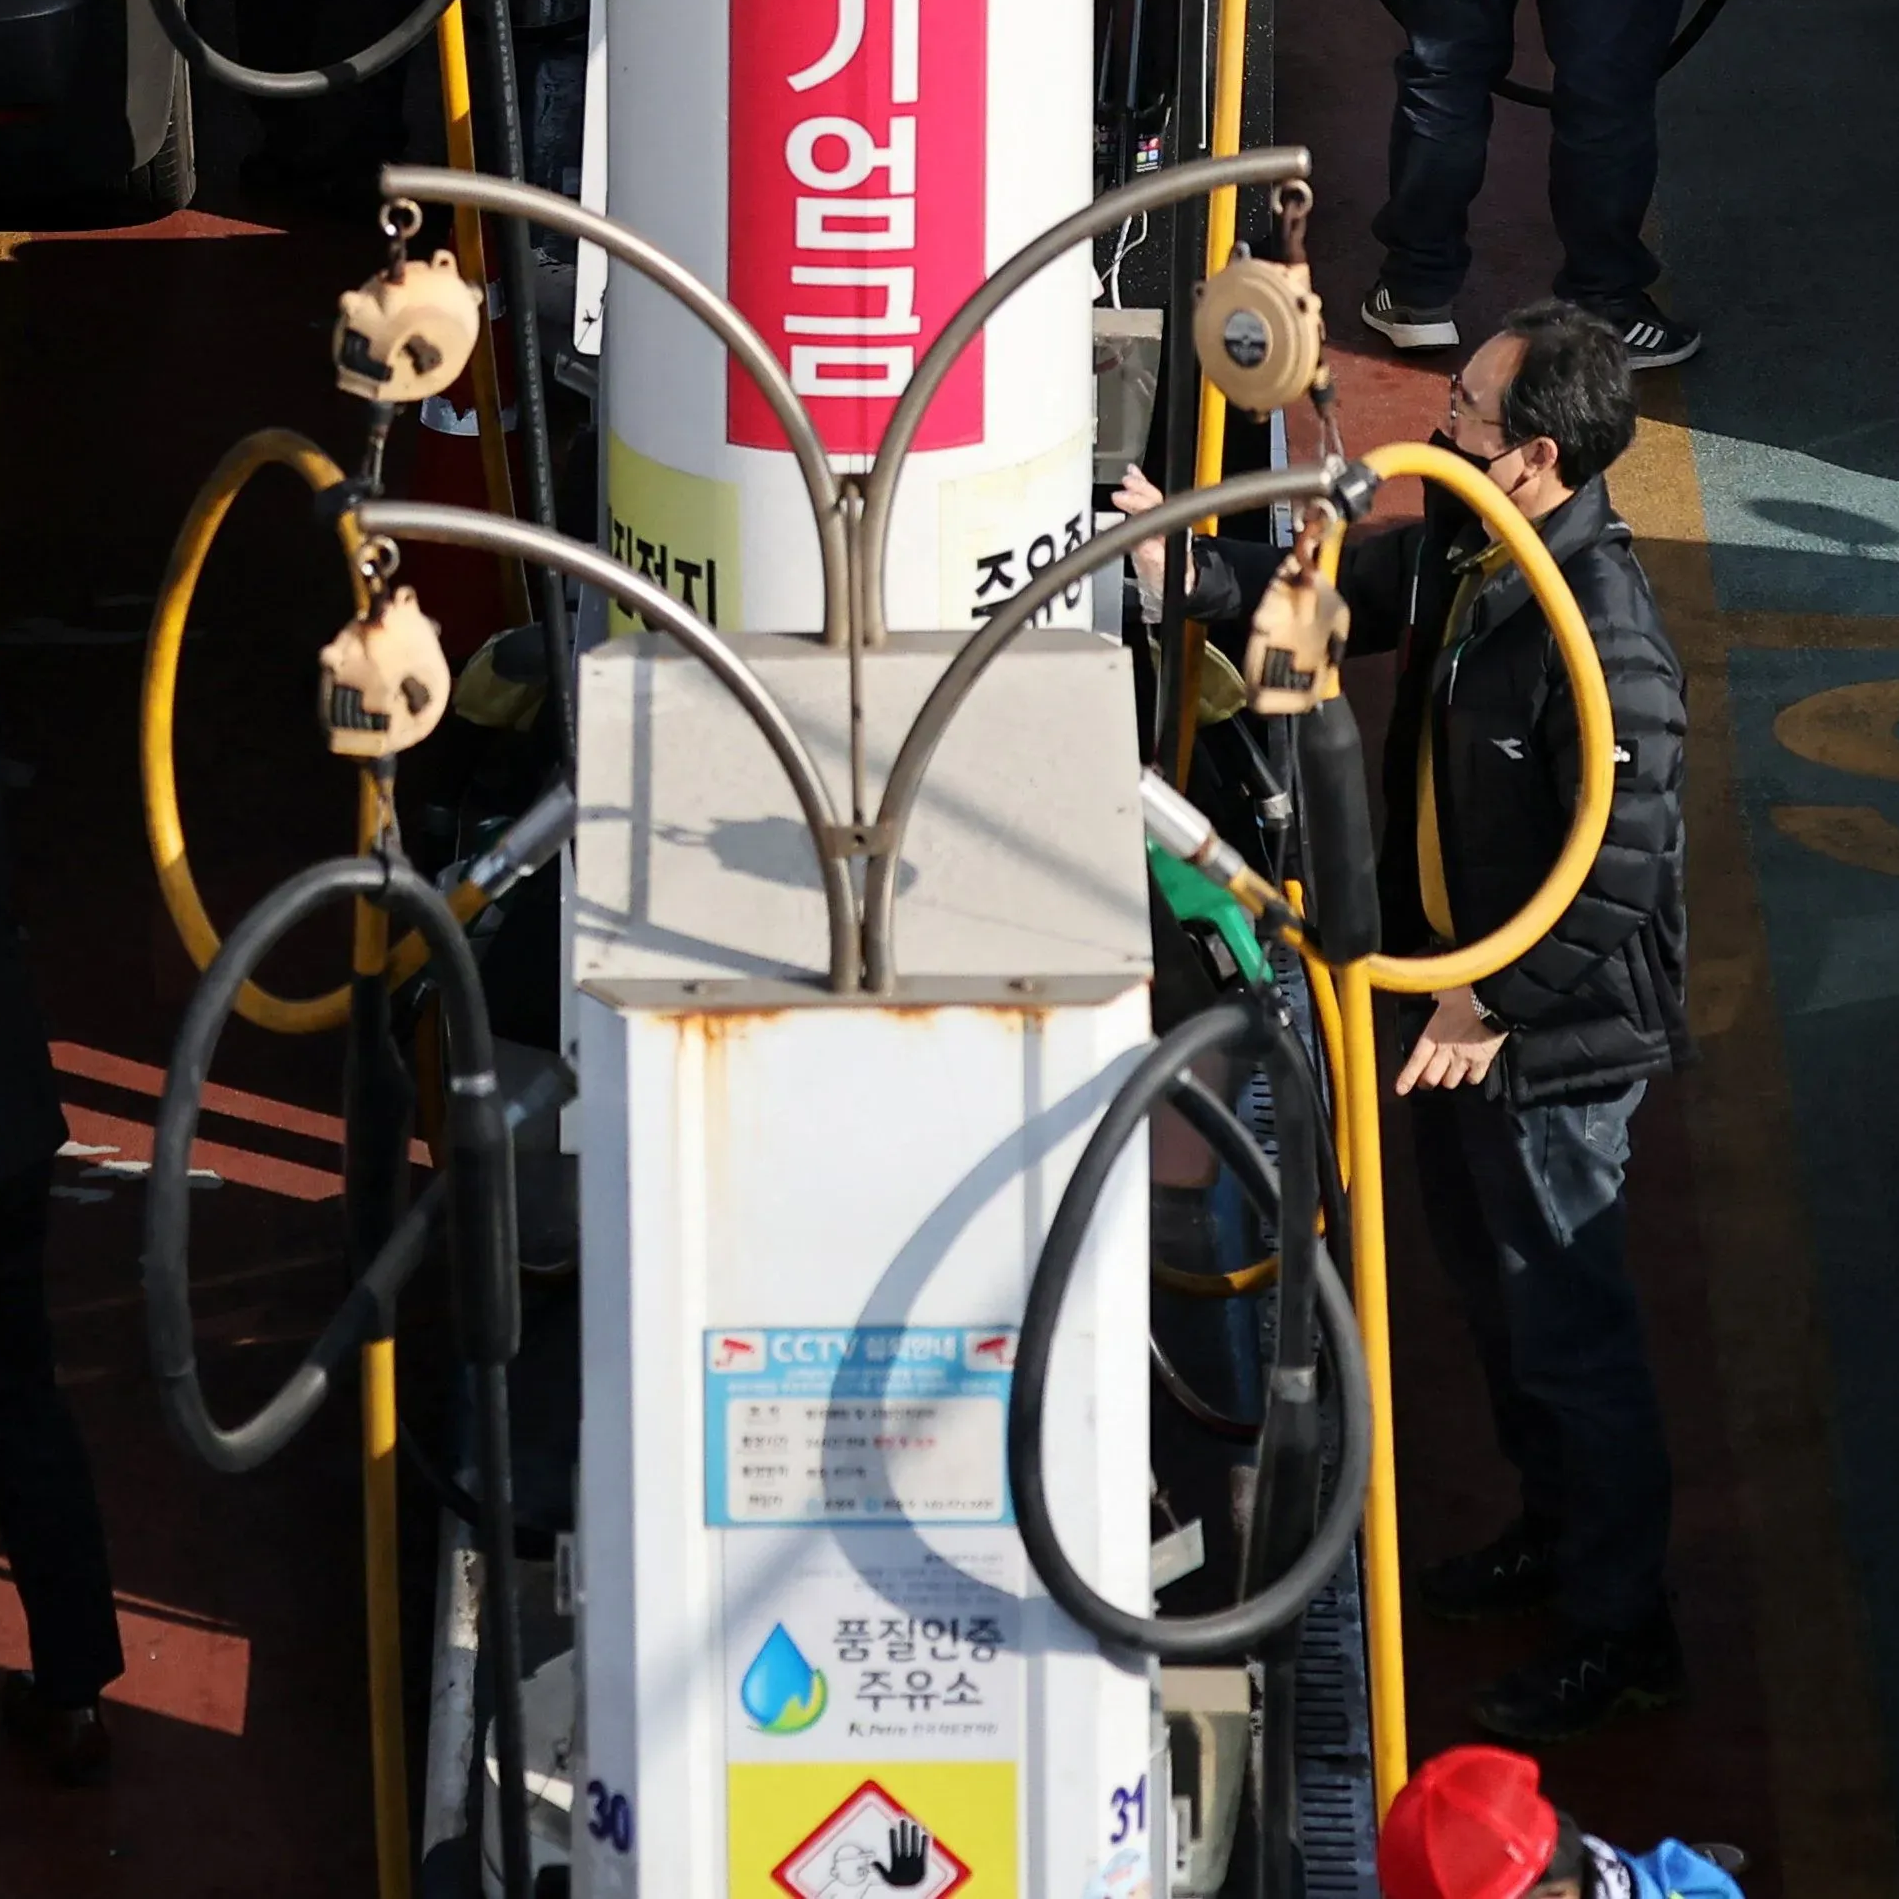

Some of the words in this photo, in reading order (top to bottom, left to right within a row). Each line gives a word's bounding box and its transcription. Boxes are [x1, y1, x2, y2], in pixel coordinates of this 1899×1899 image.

[772, 1333, 856, 1363] CCTV
[833, 1617, 1006, 1663] 품질인증
[855, 1669, 984, 1712] 주유소
[586, 1781, 632, 1853] 30
[1110, 1772, 1148, 1845] 31
